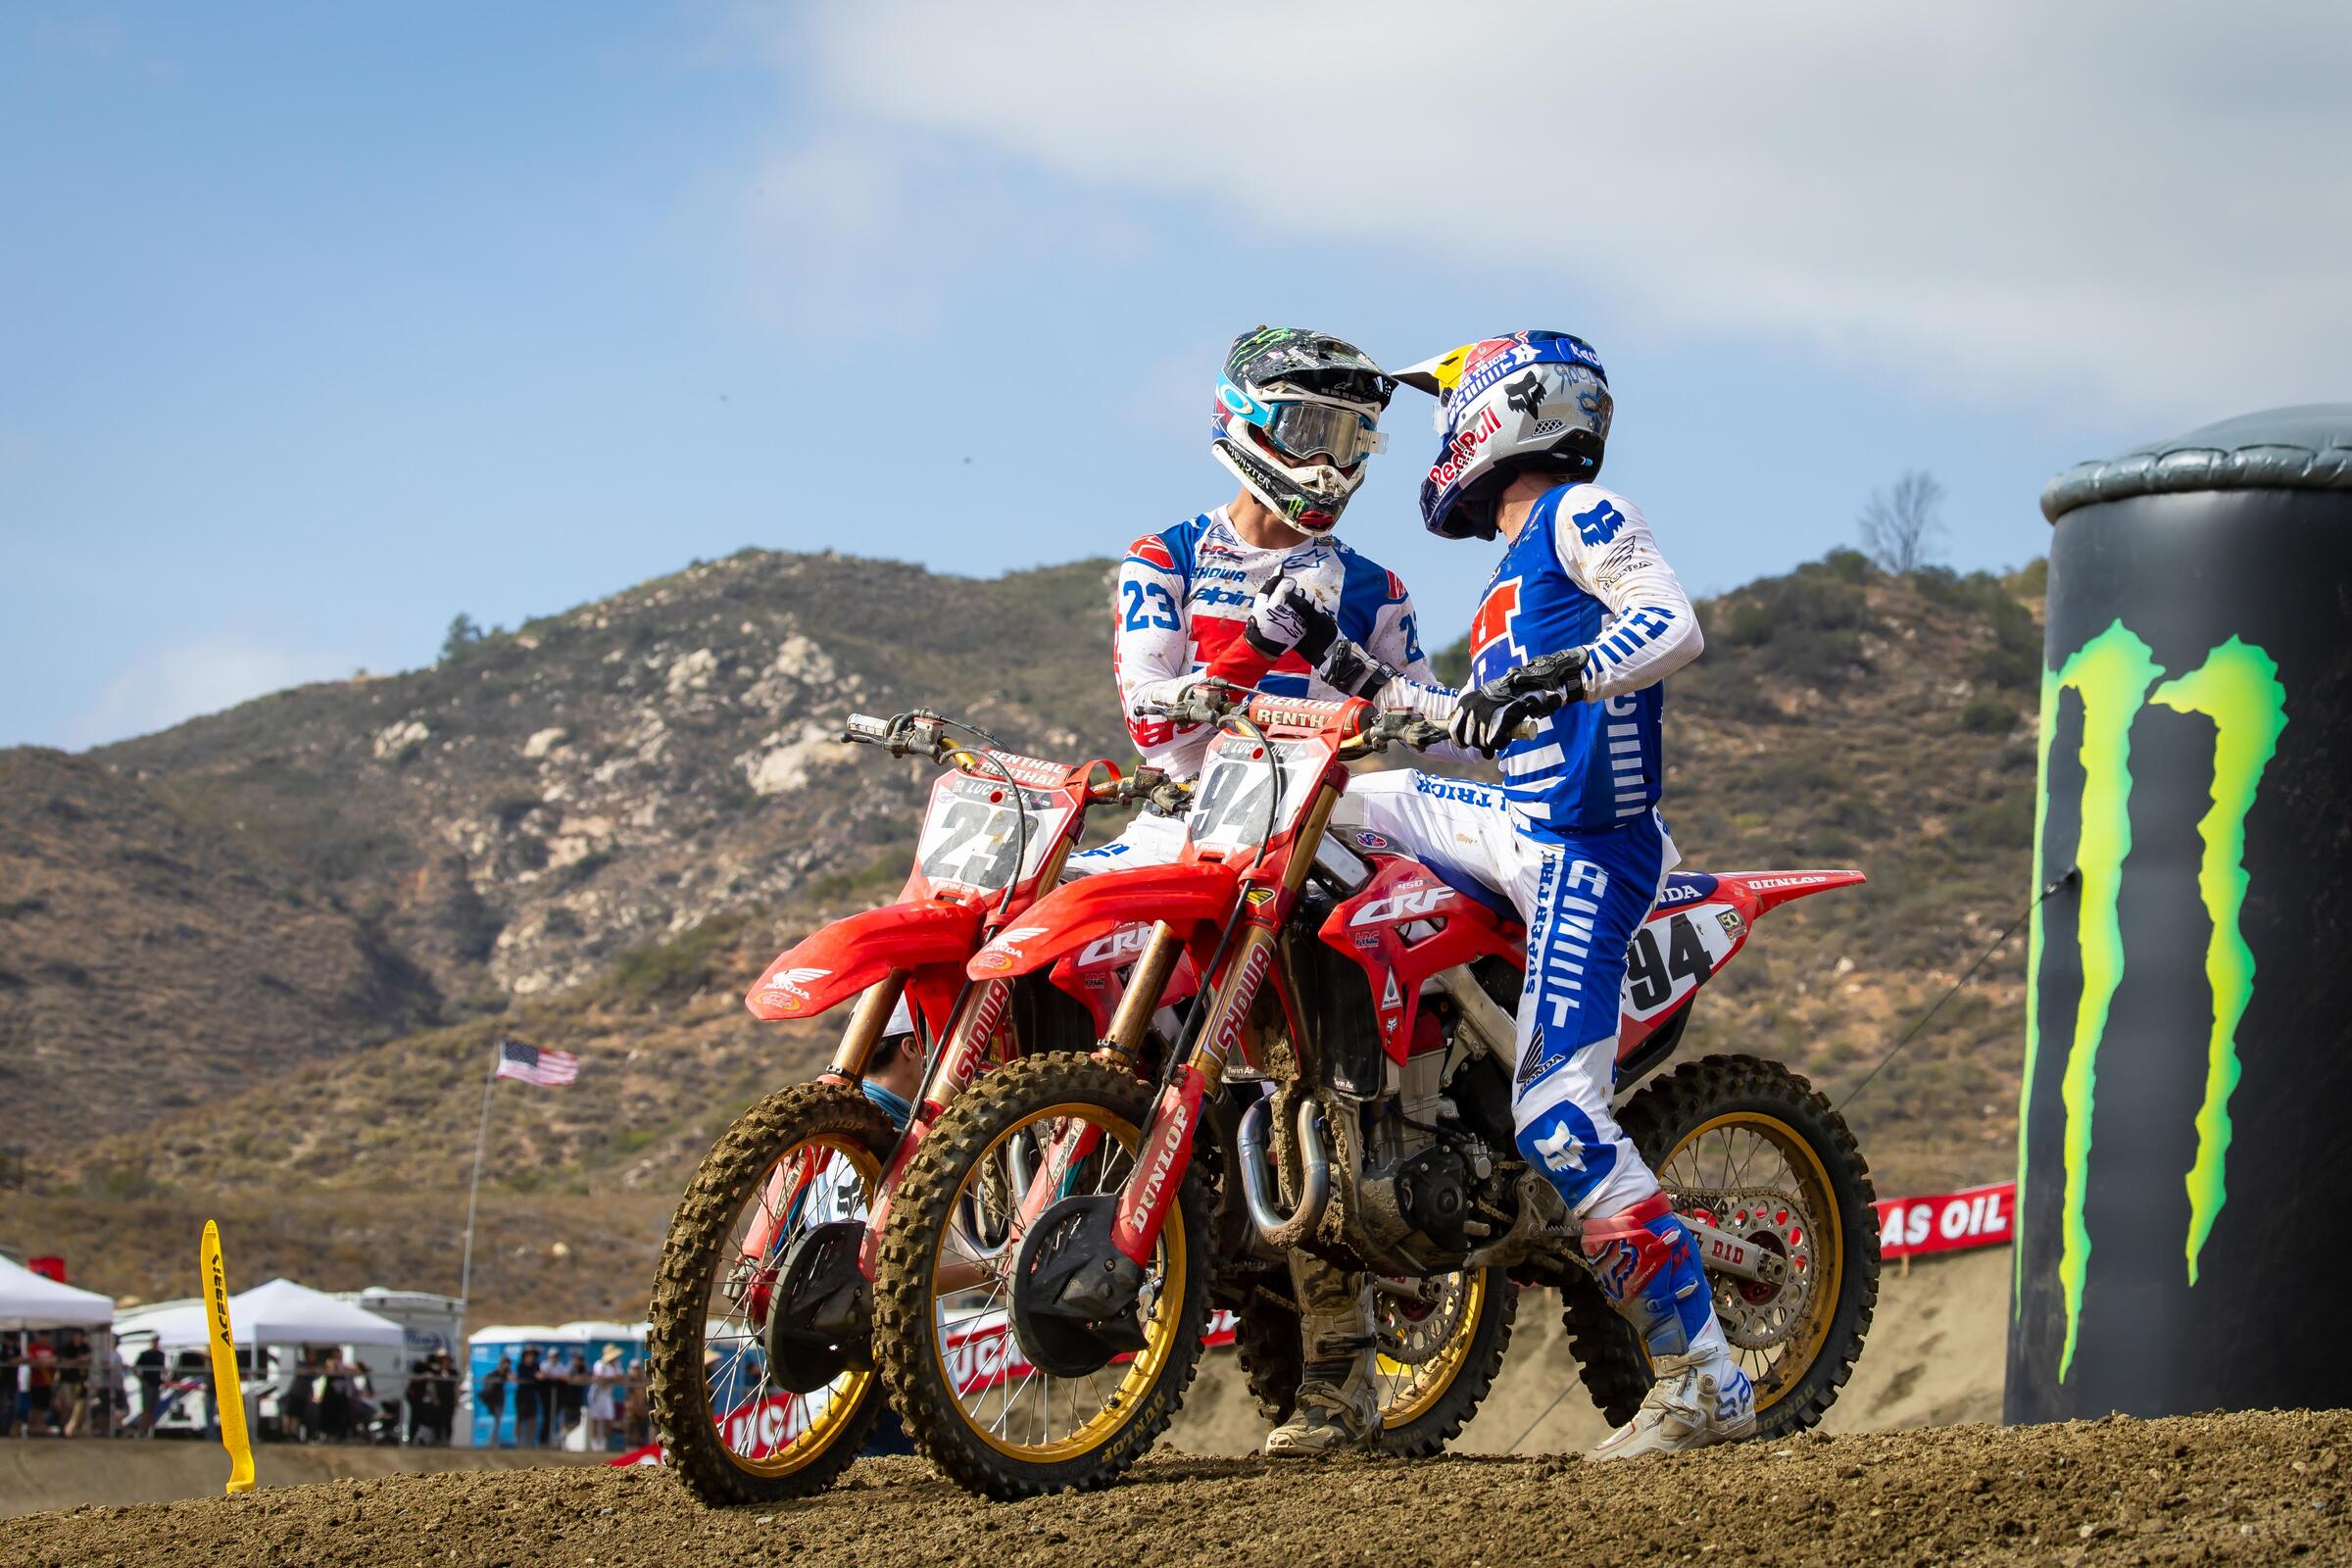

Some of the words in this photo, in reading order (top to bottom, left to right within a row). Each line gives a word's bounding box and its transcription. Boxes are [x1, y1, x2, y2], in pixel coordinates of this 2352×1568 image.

[1472, 352, 1510, 377] TRICK
[1227, 443, 1271, 489] MONSTER
[1429, 438, 1467, 495] Red
[1458, 406, 1503, 457] Bull
[1190, 566, 1247, 582] SHOWA
[1122, 580, 1181, 632] 23
[1256, 709, 1333, 729] RENTH
[1261, 695, 1344, 711] RENTHA
[987, 749, 1065, 774] RENTHAL
[1189, 761, 1298, 847] 94
[1747, 875, 1827, 890] DUNLOP
[1349, 886, 1456, 927] CRF
[1720, 911, 1740, 929] 50
[1629, 912, 1715, 1011] 94
[762, 983, 810, 1000] HONDA
[1217, 943, 1271, 1054] SHOWA
[955, 979, 1010, 1088] SHOWA
[1245, 1066, 1255, 1075] Air
[1130, 1104, 1189, 1234] DUNLOP
[1939, 1193, 2007, 1241] OIL
[949, 1334, 1029, 1384] UCA
[731, 1394, 811, 1453] UCA
[1102, 1390, 1166, 1463] DUNLOP
